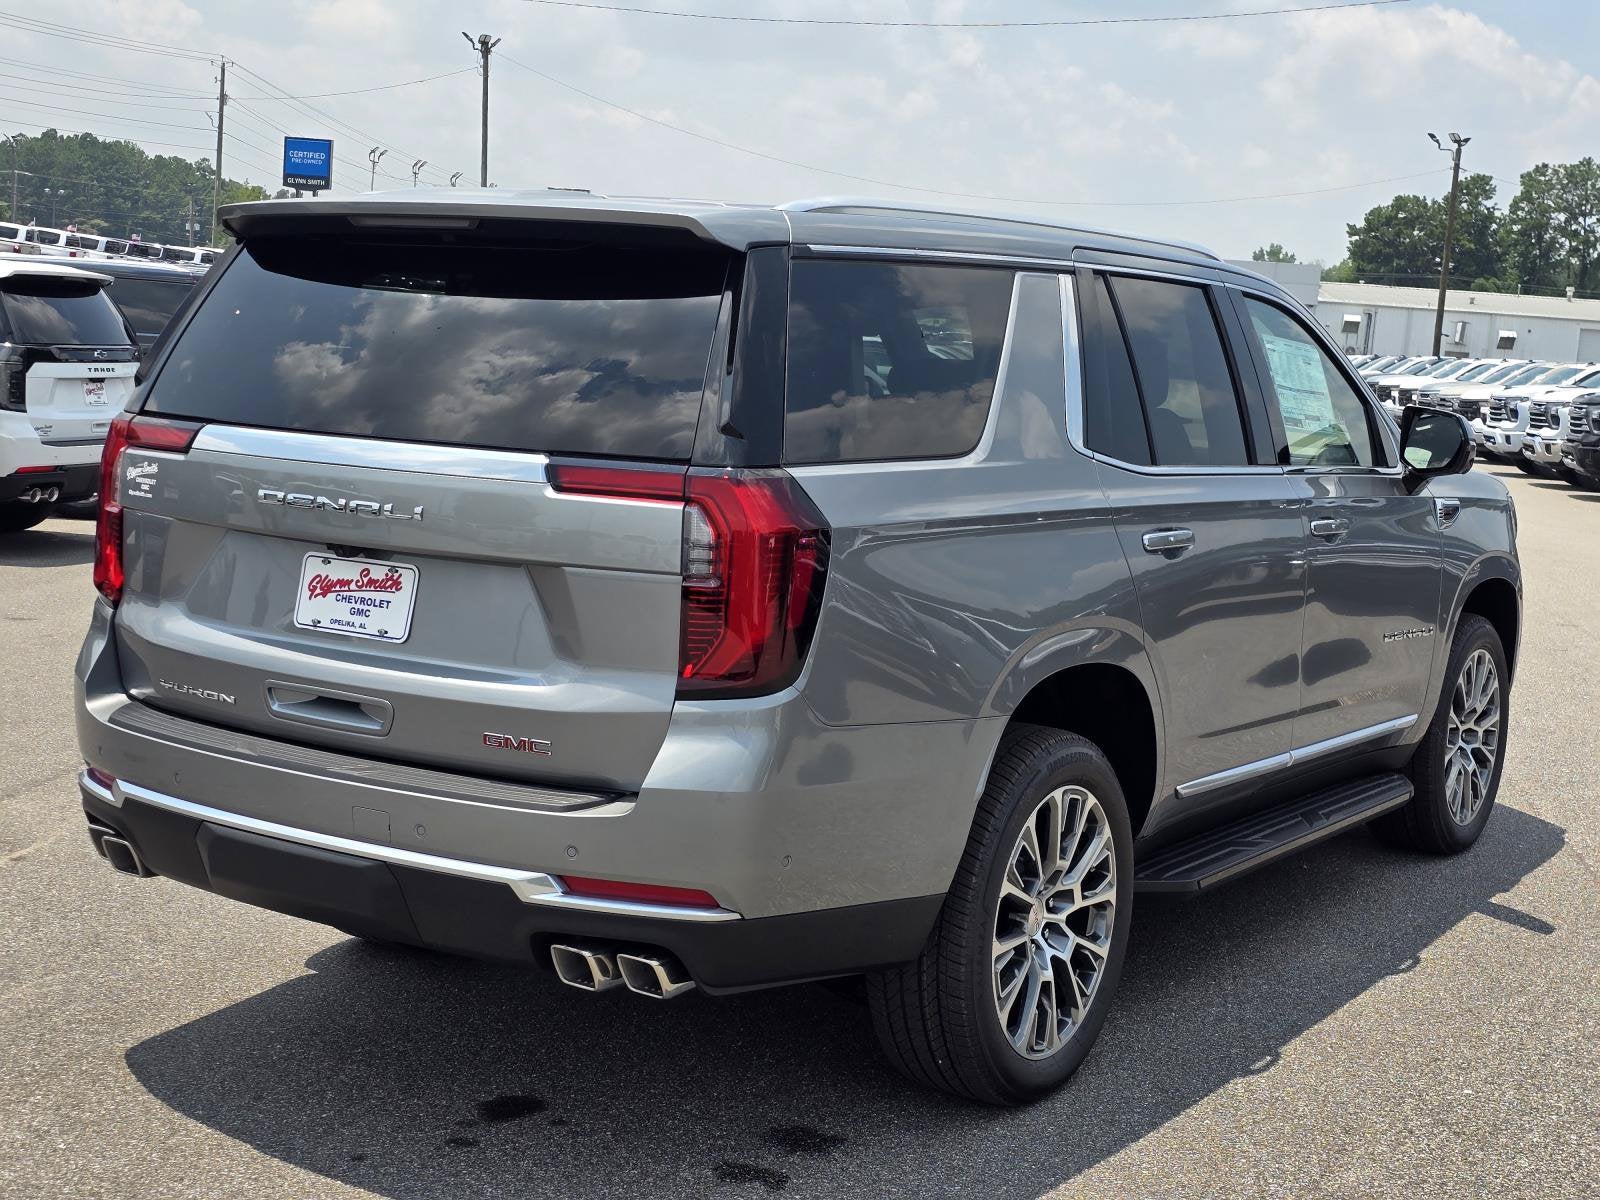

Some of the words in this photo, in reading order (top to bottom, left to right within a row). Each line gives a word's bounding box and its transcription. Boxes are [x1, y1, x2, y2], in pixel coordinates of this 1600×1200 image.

[289, 150, 325, 159] CERTIFIED
[287, 177, 307, 185] GLYNN
[257, 488, 424, 522] DENALI
[307, 573, 354, 600] Glynn
[354, 567, 403, 592] Smith
[335, 593, 392, 610] CHEVROLET
[349, 606, 371, 618] GMC
[329, 618, 357, 629] OPELIKA,
[358, 622, 367, 630] AL
[1384, 627, 1433, 642] DENALI
[159, 678, 236, 704] YUKON
[482, 731, 553, 756] GMC
